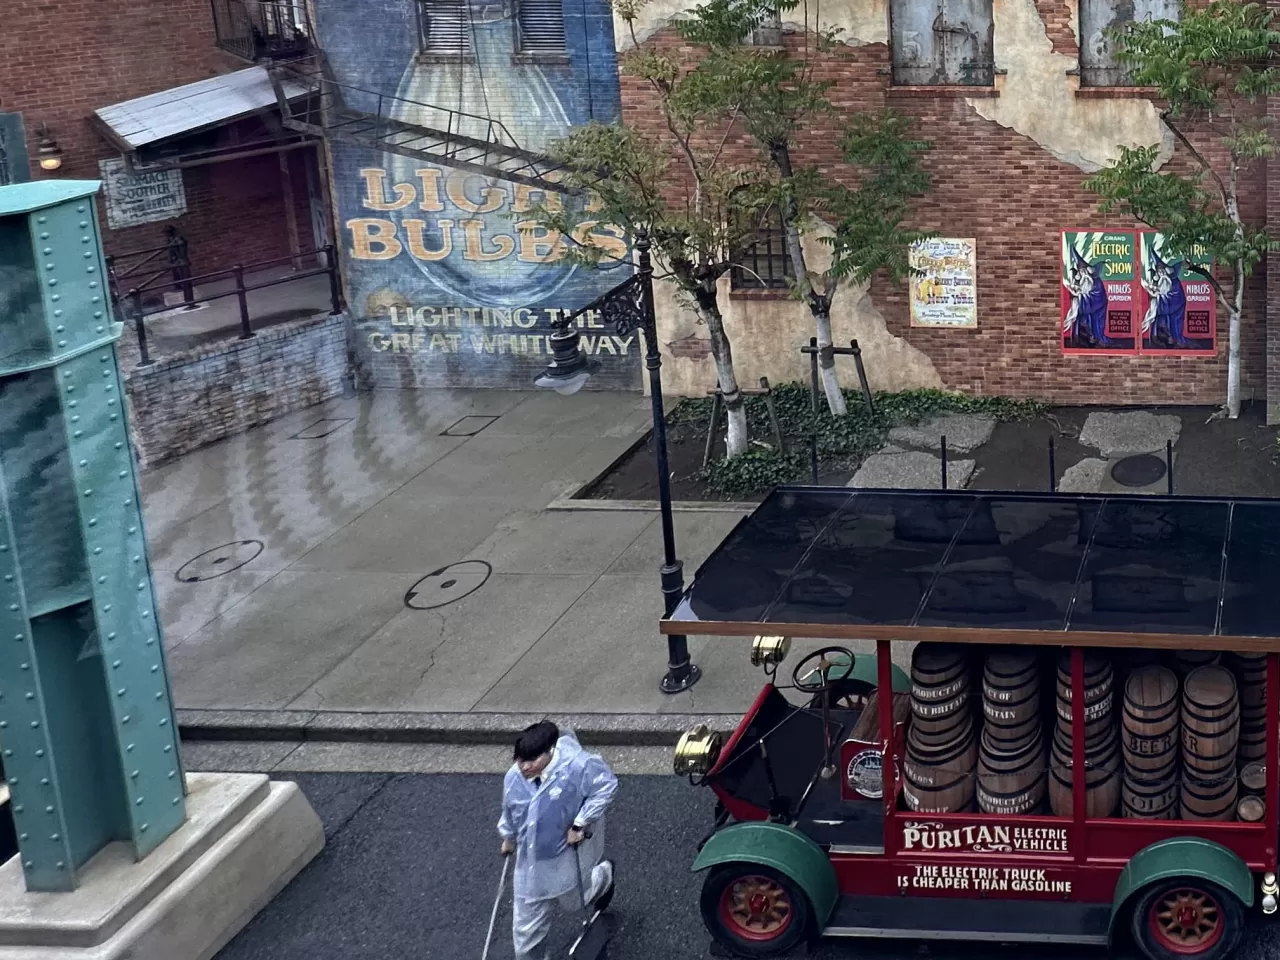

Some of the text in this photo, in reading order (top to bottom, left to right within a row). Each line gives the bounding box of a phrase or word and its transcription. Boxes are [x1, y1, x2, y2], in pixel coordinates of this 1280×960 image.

[347, 218, 628, 264] BULBS
[1092, 241, 1131, 259] ELECTRIC
[1104, 258, 1133, 277] SHOW
[390, 305, 538, 329] LIGHTING
[367, 332, 461, 356] GREAT
[577, 335, 634, 357] WAY
[912, 685, 952, 699] PRODUCT
[999, 692, 1012, 701] OF
[1128, 734, 1172, 754] BEER
[902, 825, 1068, 850] PURITAN ELECTRIC
[1013, 838, 1068, 852] VEHICLE
[915, 865, 1046, 881] THE ELECTRIC TRUCK
[898, 876, 1072, 893] IS CHEAPER THAN GASOLINE
